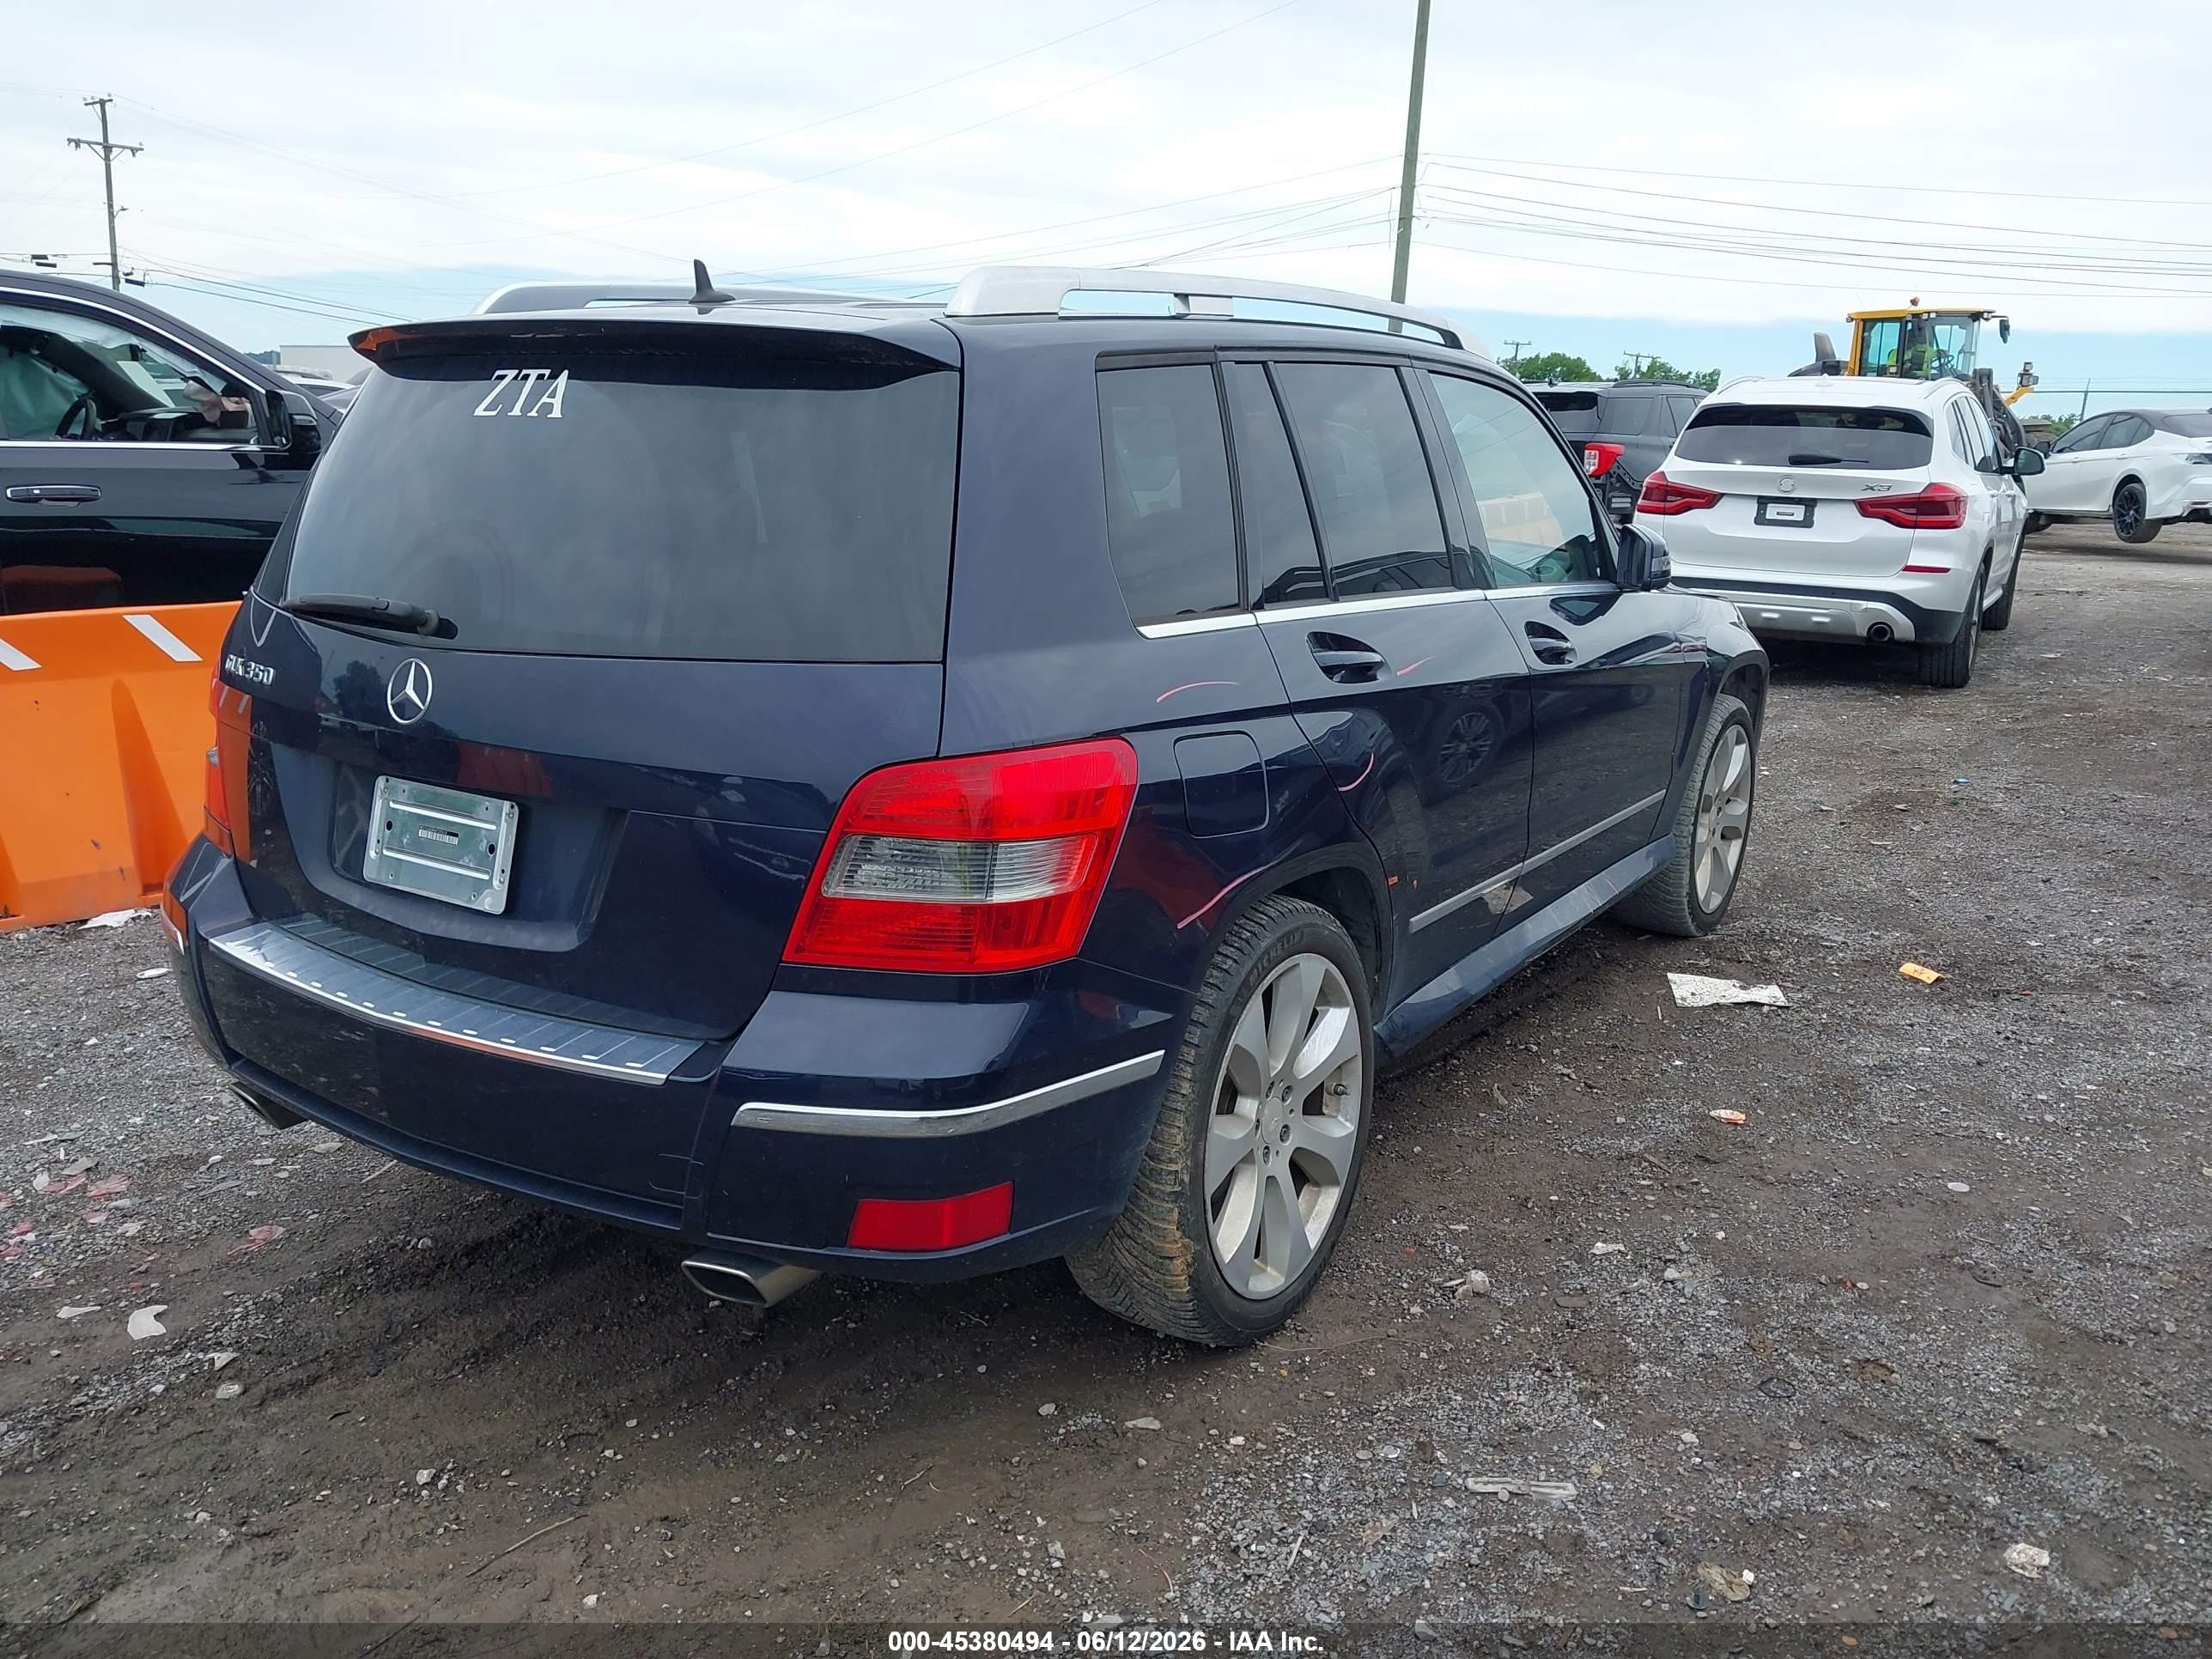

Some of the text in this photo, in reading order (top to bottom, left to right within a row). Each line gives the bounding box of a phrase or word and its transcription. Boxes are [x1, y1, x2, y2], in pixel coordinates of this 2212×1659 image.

[473, 369, 569, 418] ZTA
[1861, 483, 1893, 492] X3
[245, 661, 276, 686] 350
[1249, 928, 1305, 988] MICHELIN
